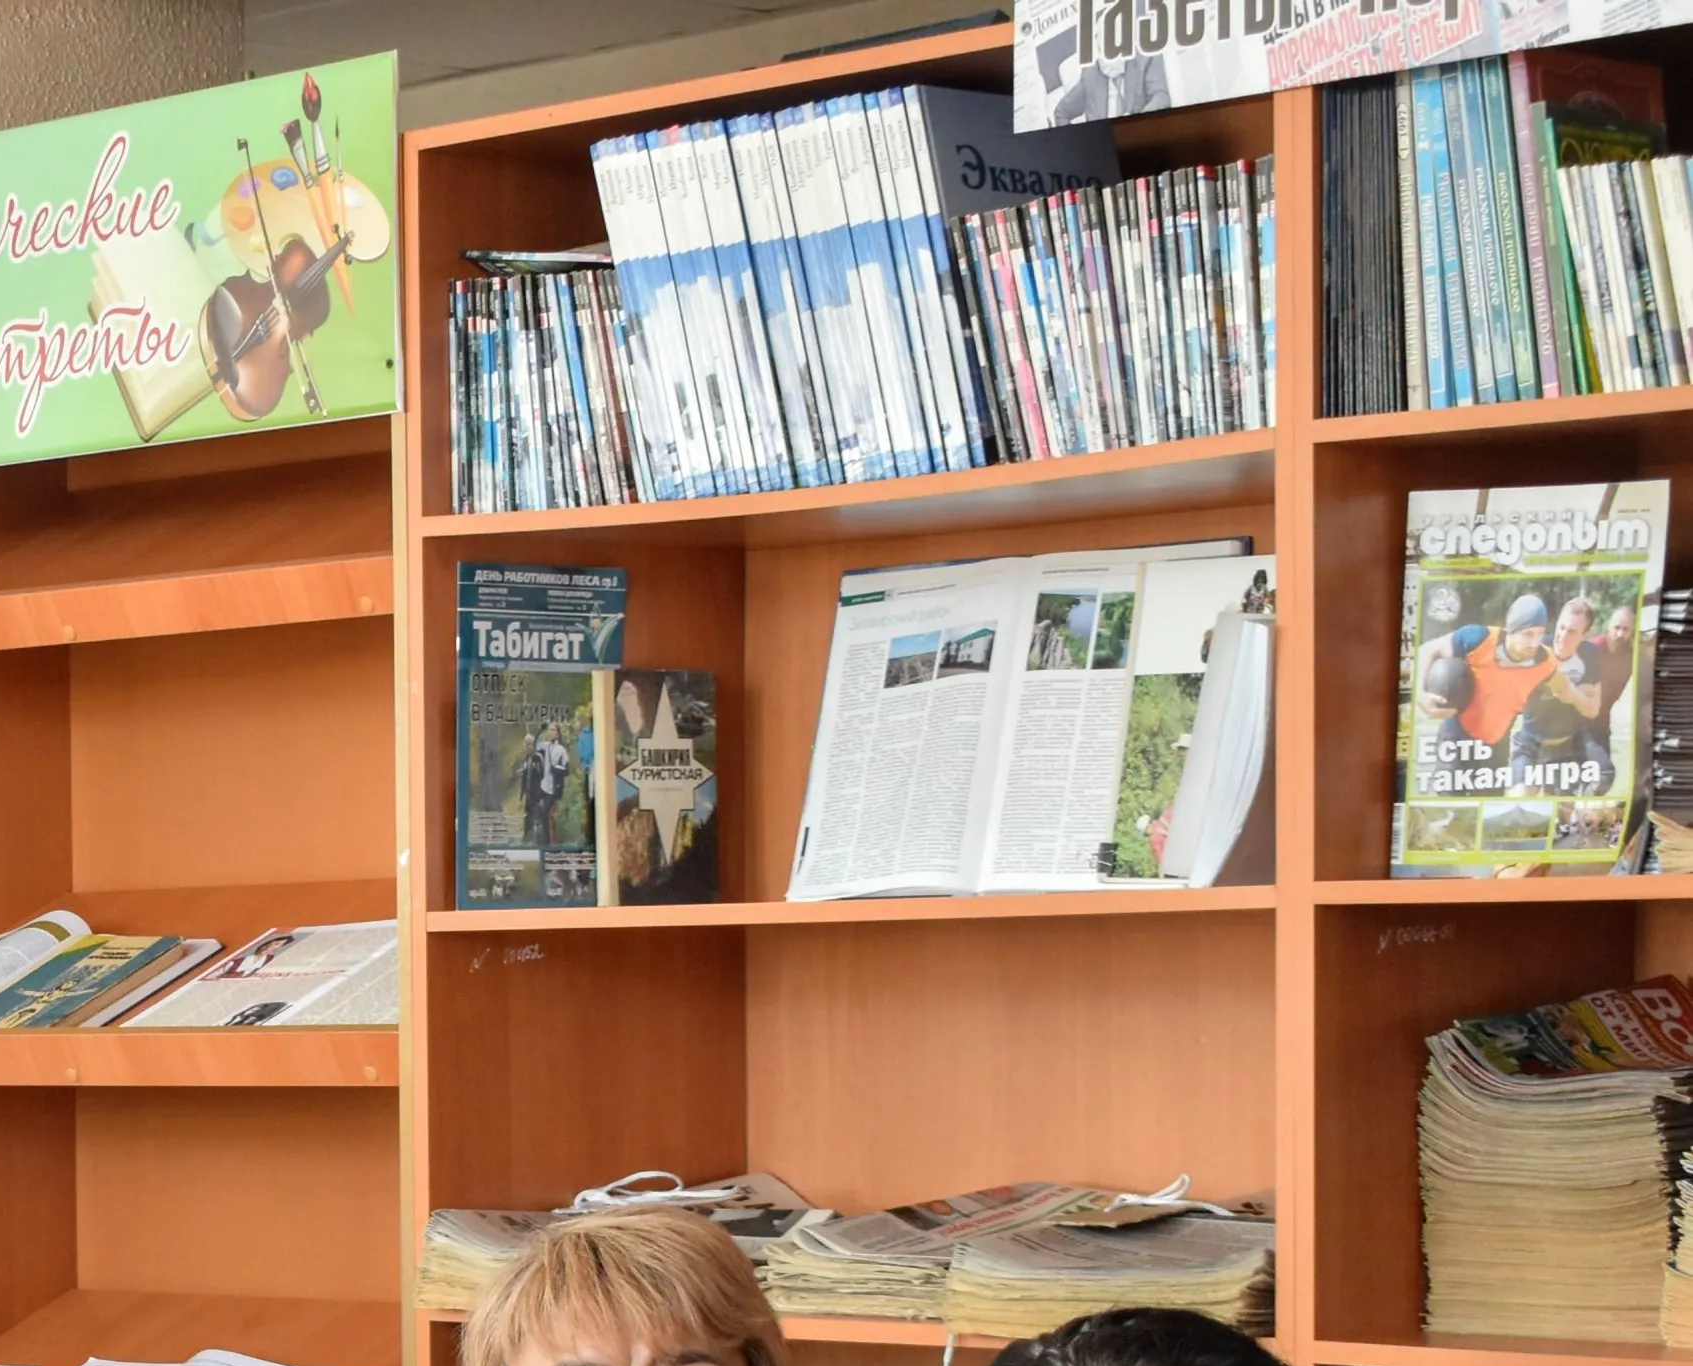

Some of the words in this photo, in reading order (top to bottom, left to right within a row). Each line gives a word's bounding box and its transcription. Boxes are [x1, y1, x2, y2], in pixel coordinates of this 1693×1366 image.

[1420, 509, 1649, 565] следопыт
[474, 570, 503, 582] ДЕНЬ
[504, 572, 570, 585] РАБОТНИКОВ
[572, 575, 600, 586] ЛЕСА
[473, 620, 585, 660] Табигат
[471, 703, 480, 723] В
[485, 702, 572, 724] БАШКИРИИ
[641, 748, 691, 766] БАШКИРИЯ
[1417, 737, 1493, 765] Есть
[630, 768, 703, 781] ТУРИСТСКАЯ
[1416, 766, 1513, 793] такая
[1524, 761, 1600, 794] игра
